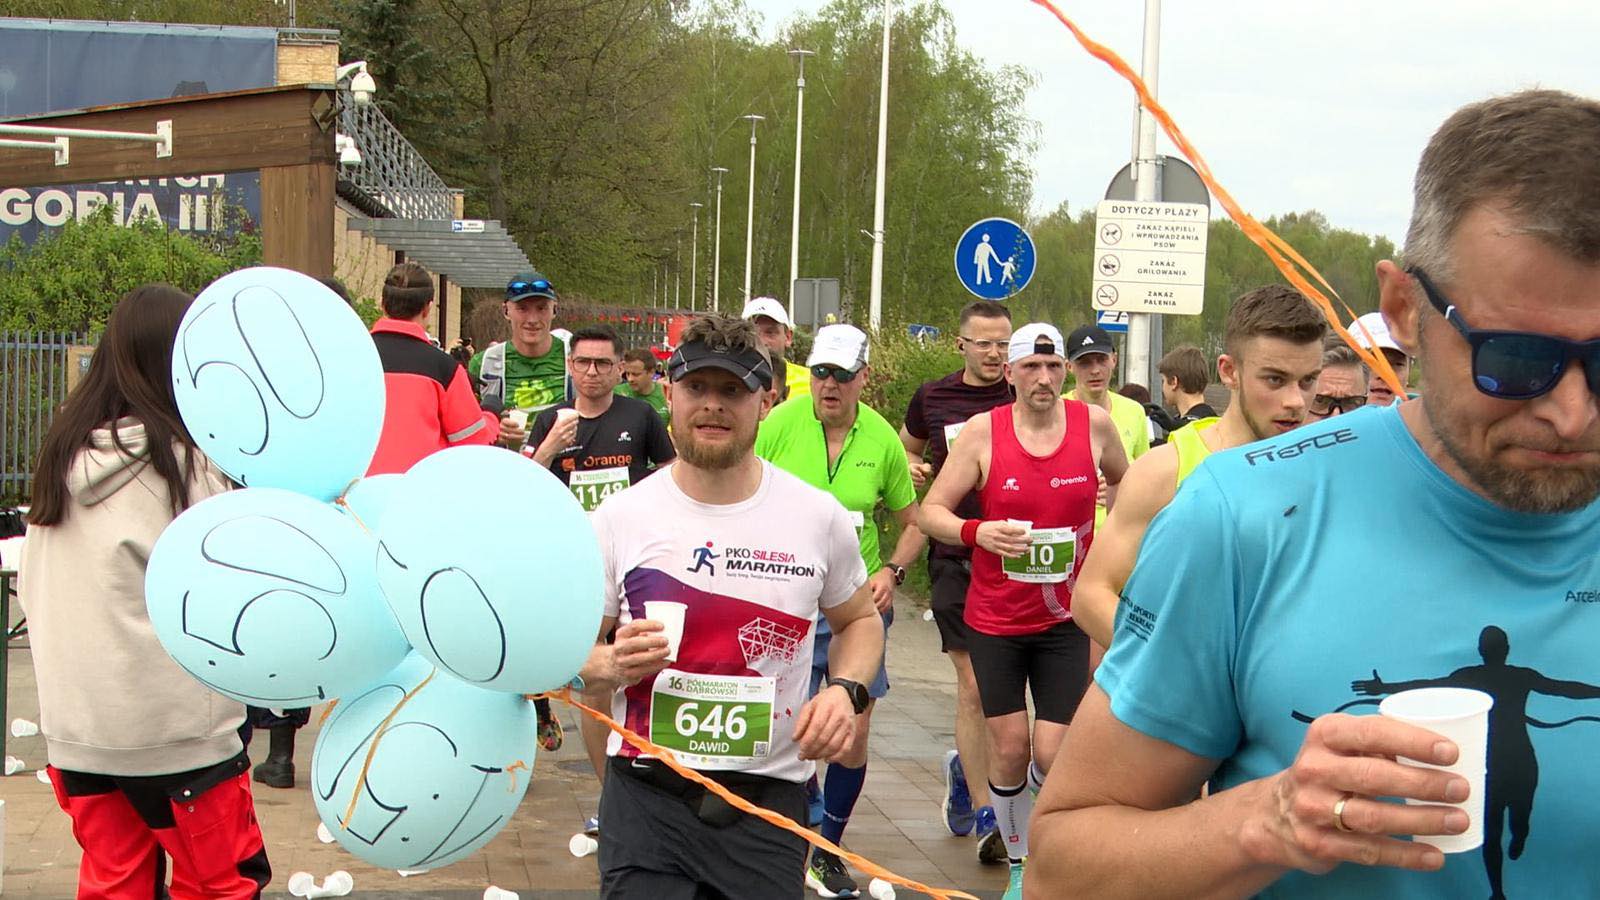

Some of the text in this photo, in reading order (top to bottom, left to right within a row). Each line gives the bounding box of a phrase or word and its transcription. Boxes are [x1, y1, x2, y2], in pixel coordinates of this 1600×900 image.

[1111, 205, 1161, 215] DOTYCZY
[1136, 233, 1199, 241] WPROWADZANIA
[1137, 268, 1187, 276] GRILOWANIA
[584, 454, 632, 467] Orange
[1060, 475, 1088, 486] brembo
[725, 547, 796, 563] PKO SILESIA
[1029, 544, 1054, 566] 10
[726, 560, 815, 577] MARATHON
[668, 676, 685, 691] 16.
[675, 702, 747, 740] 646
[689, 740, 730, 753] DAWID
